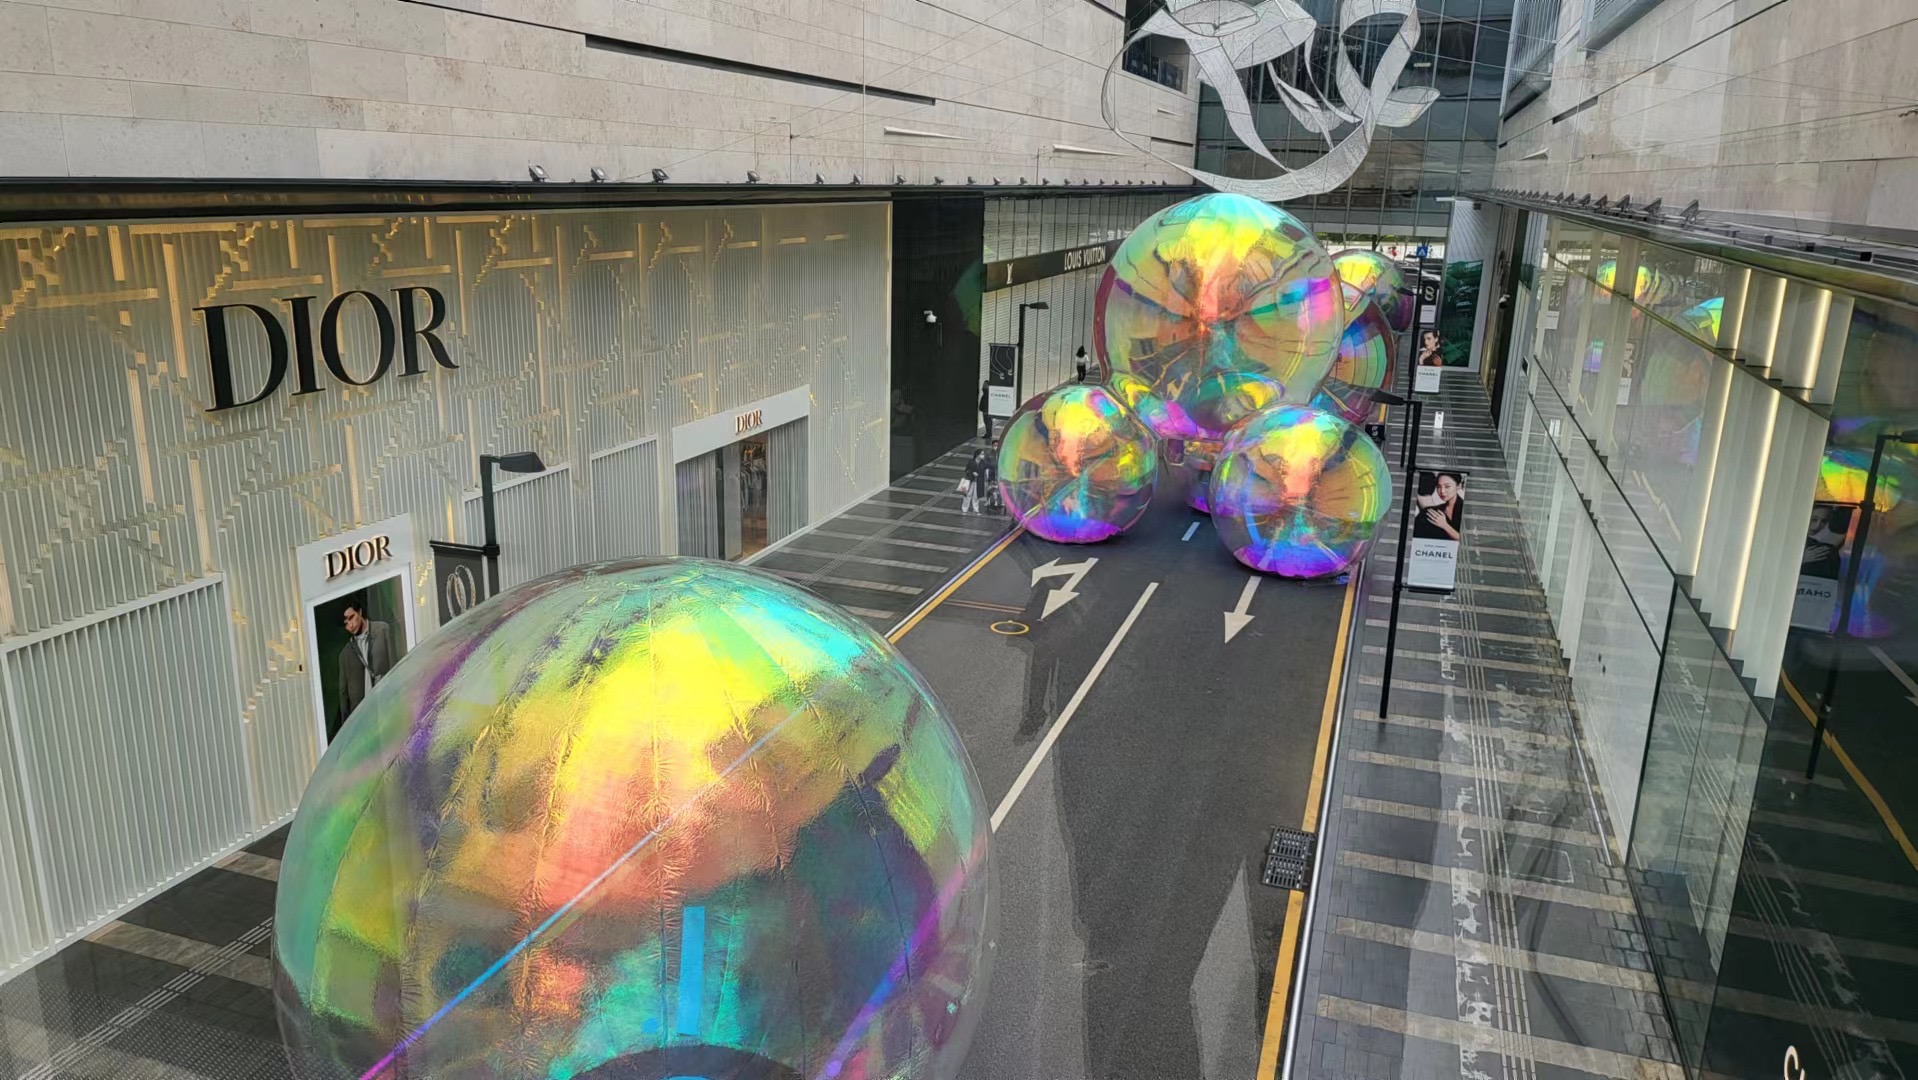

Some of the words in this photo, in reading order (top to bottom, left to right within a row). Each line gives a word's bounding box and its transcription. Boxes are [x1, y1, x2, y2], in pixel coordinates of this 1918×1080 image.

[1064, 249, 1082, 271] LOUIS
[1083, 245, 1106, 267] VUITTON
[192, 286, 460, 412] DIOR
[734, 409, 763, 433] DIOR
[323, 535, 393, 580] DIOR
[1415, 549, 1453, 559] CHANEL
